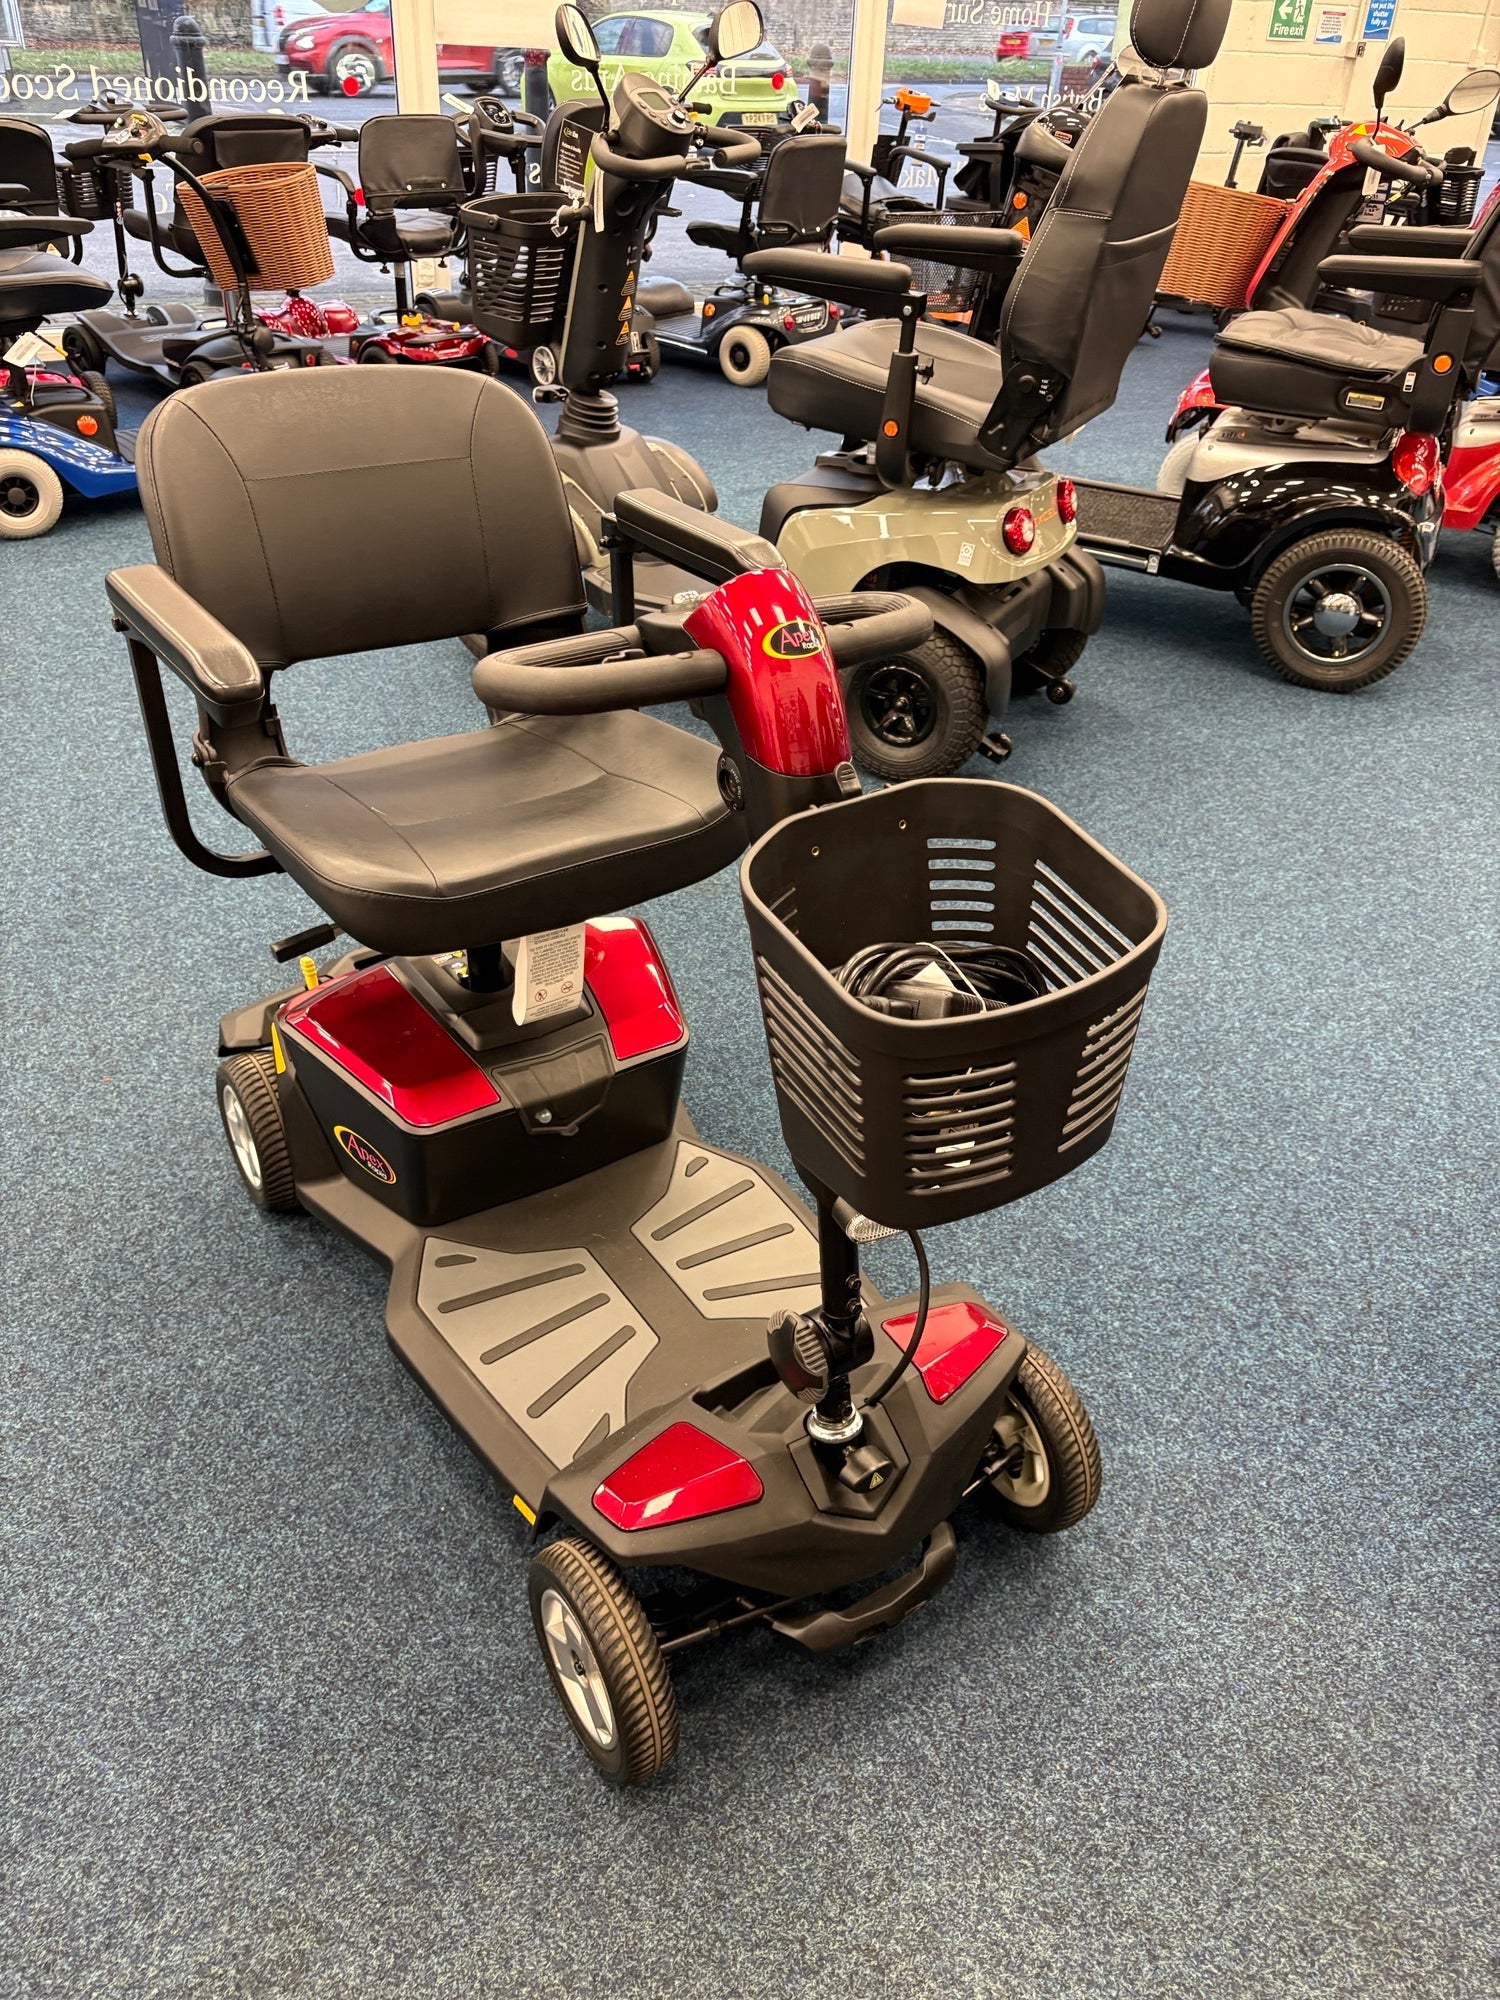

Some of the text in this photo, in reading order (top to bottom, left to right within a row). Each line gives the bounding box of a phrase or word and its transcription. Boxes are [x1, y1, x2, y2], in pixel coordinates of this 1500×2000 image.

[1273, 23, 1290, 36] Fire
[1290, 25, 1305, 37] exit
[347, 1134, 385, 1173] Apex
